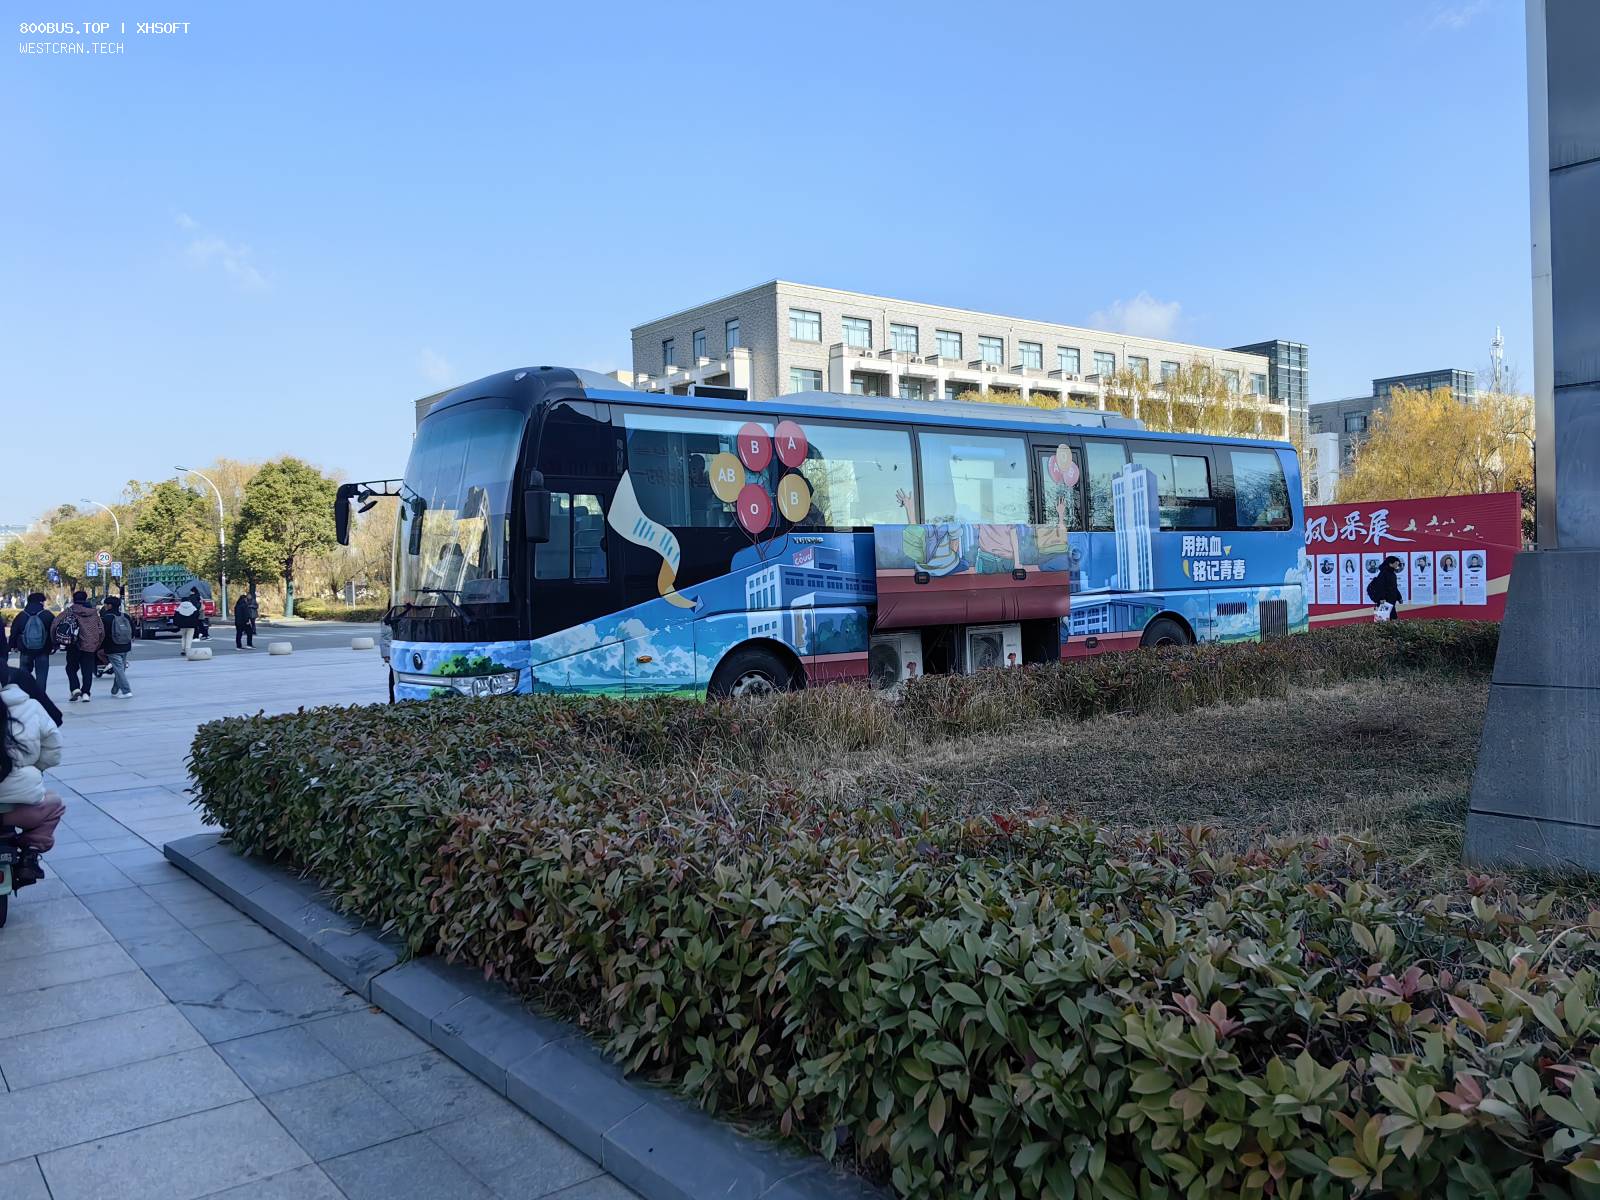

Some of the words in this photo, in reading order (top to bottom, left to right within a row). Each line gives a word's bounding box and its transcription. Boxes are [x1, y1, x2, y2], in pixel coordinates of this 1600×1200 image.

[751, 441, 759, 454] B
[788, 436, 796, 450] A
[1053, 462, 1060, 473] A
[718, 468, 736, 483] AB
[790, 491, 799, 505] B
[751, 504, 759, 515] O
[1304, 508, 1416, 546] 风采展
[1181, 535, 1222, 557] 用热血
[1192, 559, 1246, 582] 铭记青春
